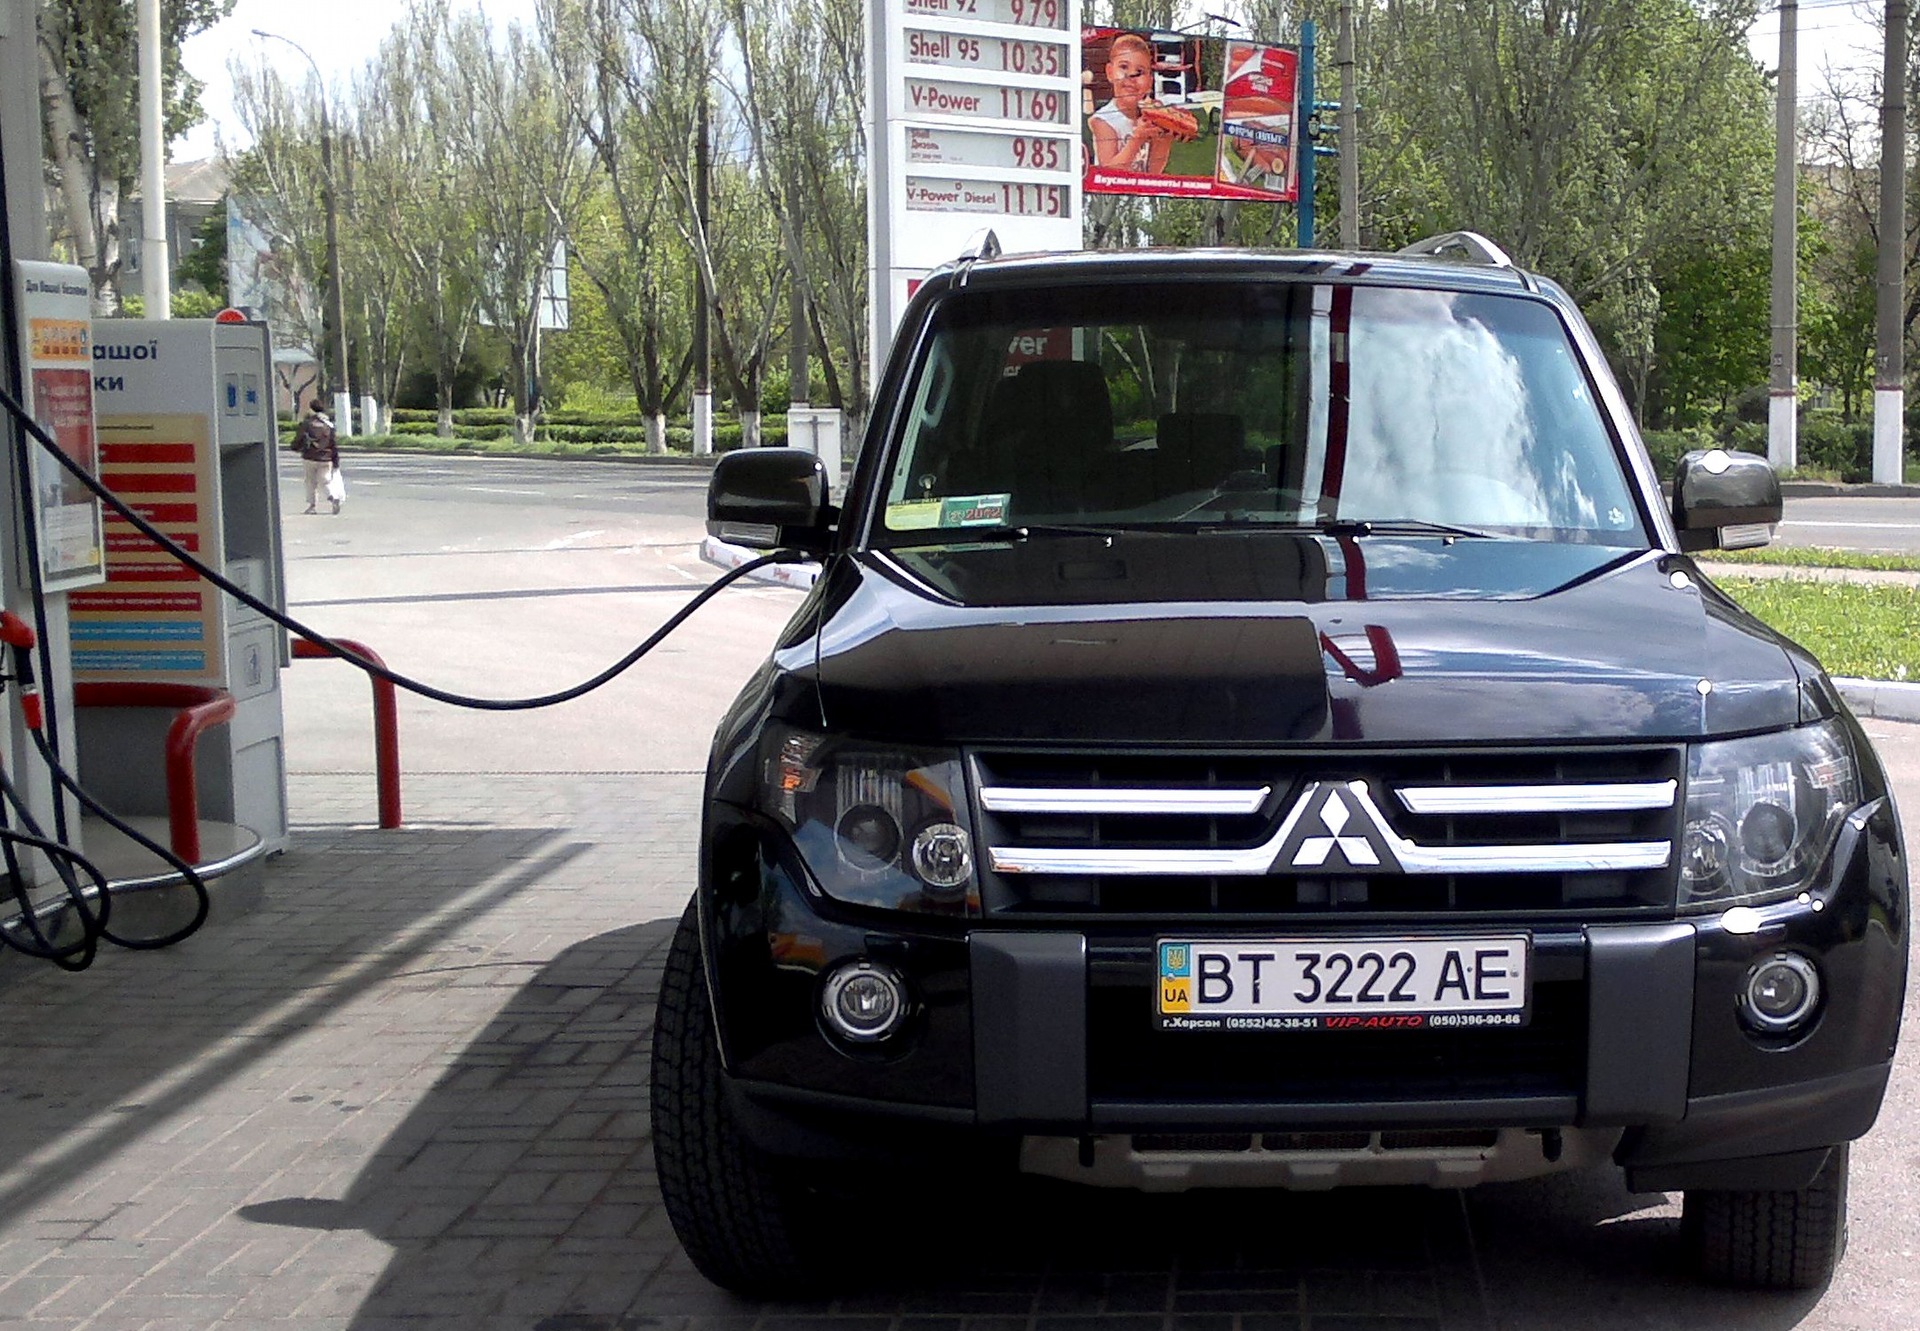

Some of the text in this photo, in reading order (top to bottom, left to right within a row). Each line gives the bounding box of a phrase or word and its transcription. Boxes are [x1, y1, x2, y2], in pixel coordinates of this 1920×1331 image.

[957, 0, 976, 13] 92
[909, 33, 950, 58] Shell
[957, 39, 980, 61] 95
[911, 85, 980, 111] V-Power
[1012, 137, 1058, 169] 9.85
[907, 188, 959, 202] V-Power
[965, 191, 996, 204] Diesel
[1002, 184, 1060, 215] 11.15
[92, 339, 158, 360] ашої
[1198, 949, 1510, 1005] BT 3222 AE
[1164, 988, 1188, 1003] UA
[1325, 1015, 1423, 1028] VIP-AUTO
